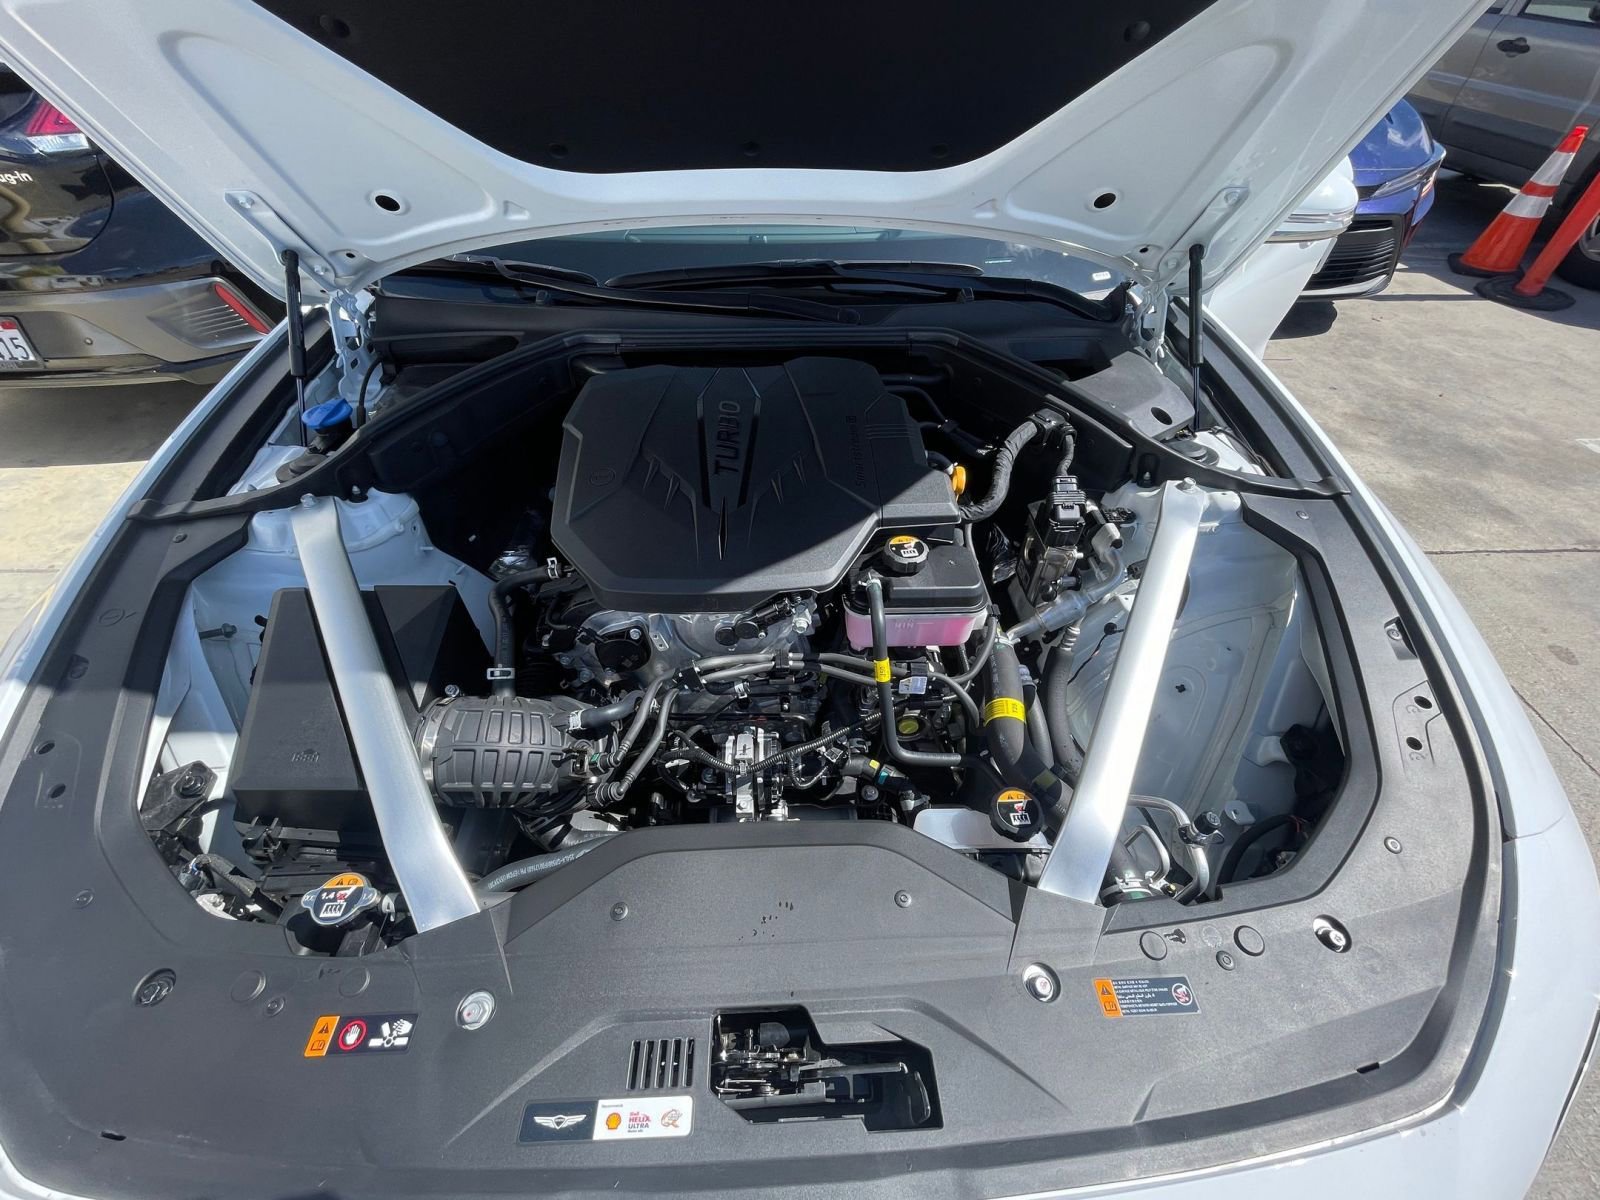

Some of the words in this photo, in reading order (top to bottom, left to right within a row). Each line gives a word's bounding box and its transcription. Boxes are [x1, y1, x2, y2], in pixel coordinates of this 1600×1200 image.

[0, 337, 29, 360] 15
[714, 400, 741, 475] TURBO
[321, 891, 336, 900] 1.4
